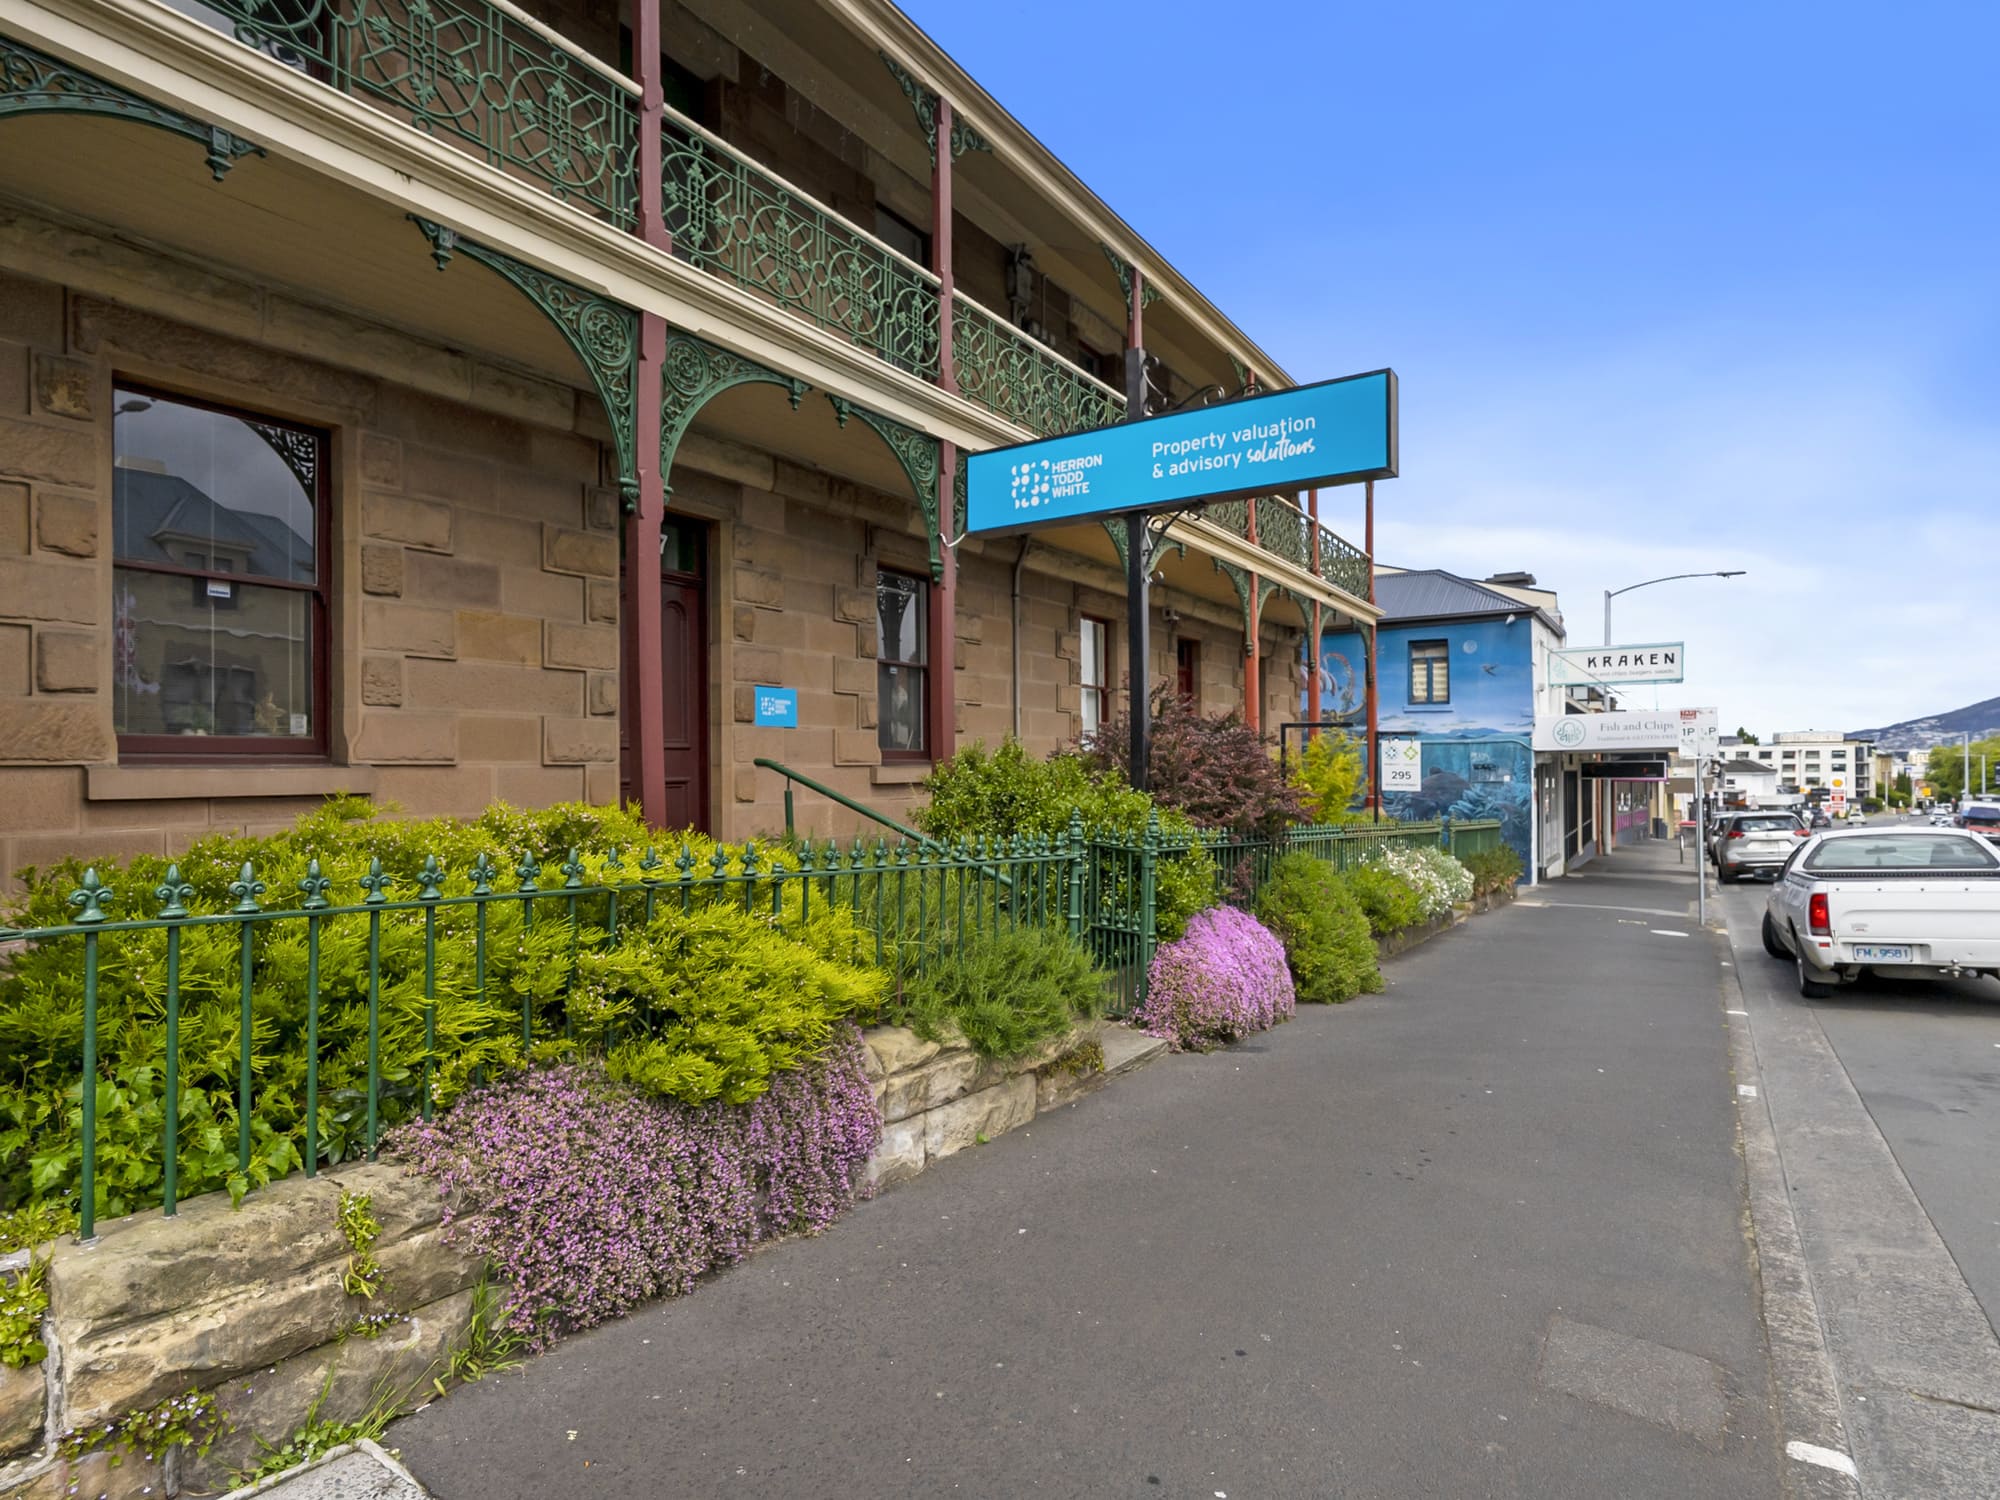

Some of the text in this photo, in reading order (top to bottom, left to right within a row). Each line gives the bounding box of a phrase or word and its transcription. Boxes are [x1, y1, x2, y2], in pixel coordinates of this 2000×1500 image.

[1152, 416, 1317, 458] Property valuation
[1051, 454, 1103, 474] HERRON
[1152, 437, 1317, 479] & advisory solutions
[1051, 470, 1084, 486] TODD
[1052, 481, 1090, 499] WHITE
[1587, 652, 1675, 668] KRAKEN
[1600, 720, 1674, 733] Fish and Chips
[1682, 727, 1696, 736] 1P
[1391, 770, 1412, 780] 295
